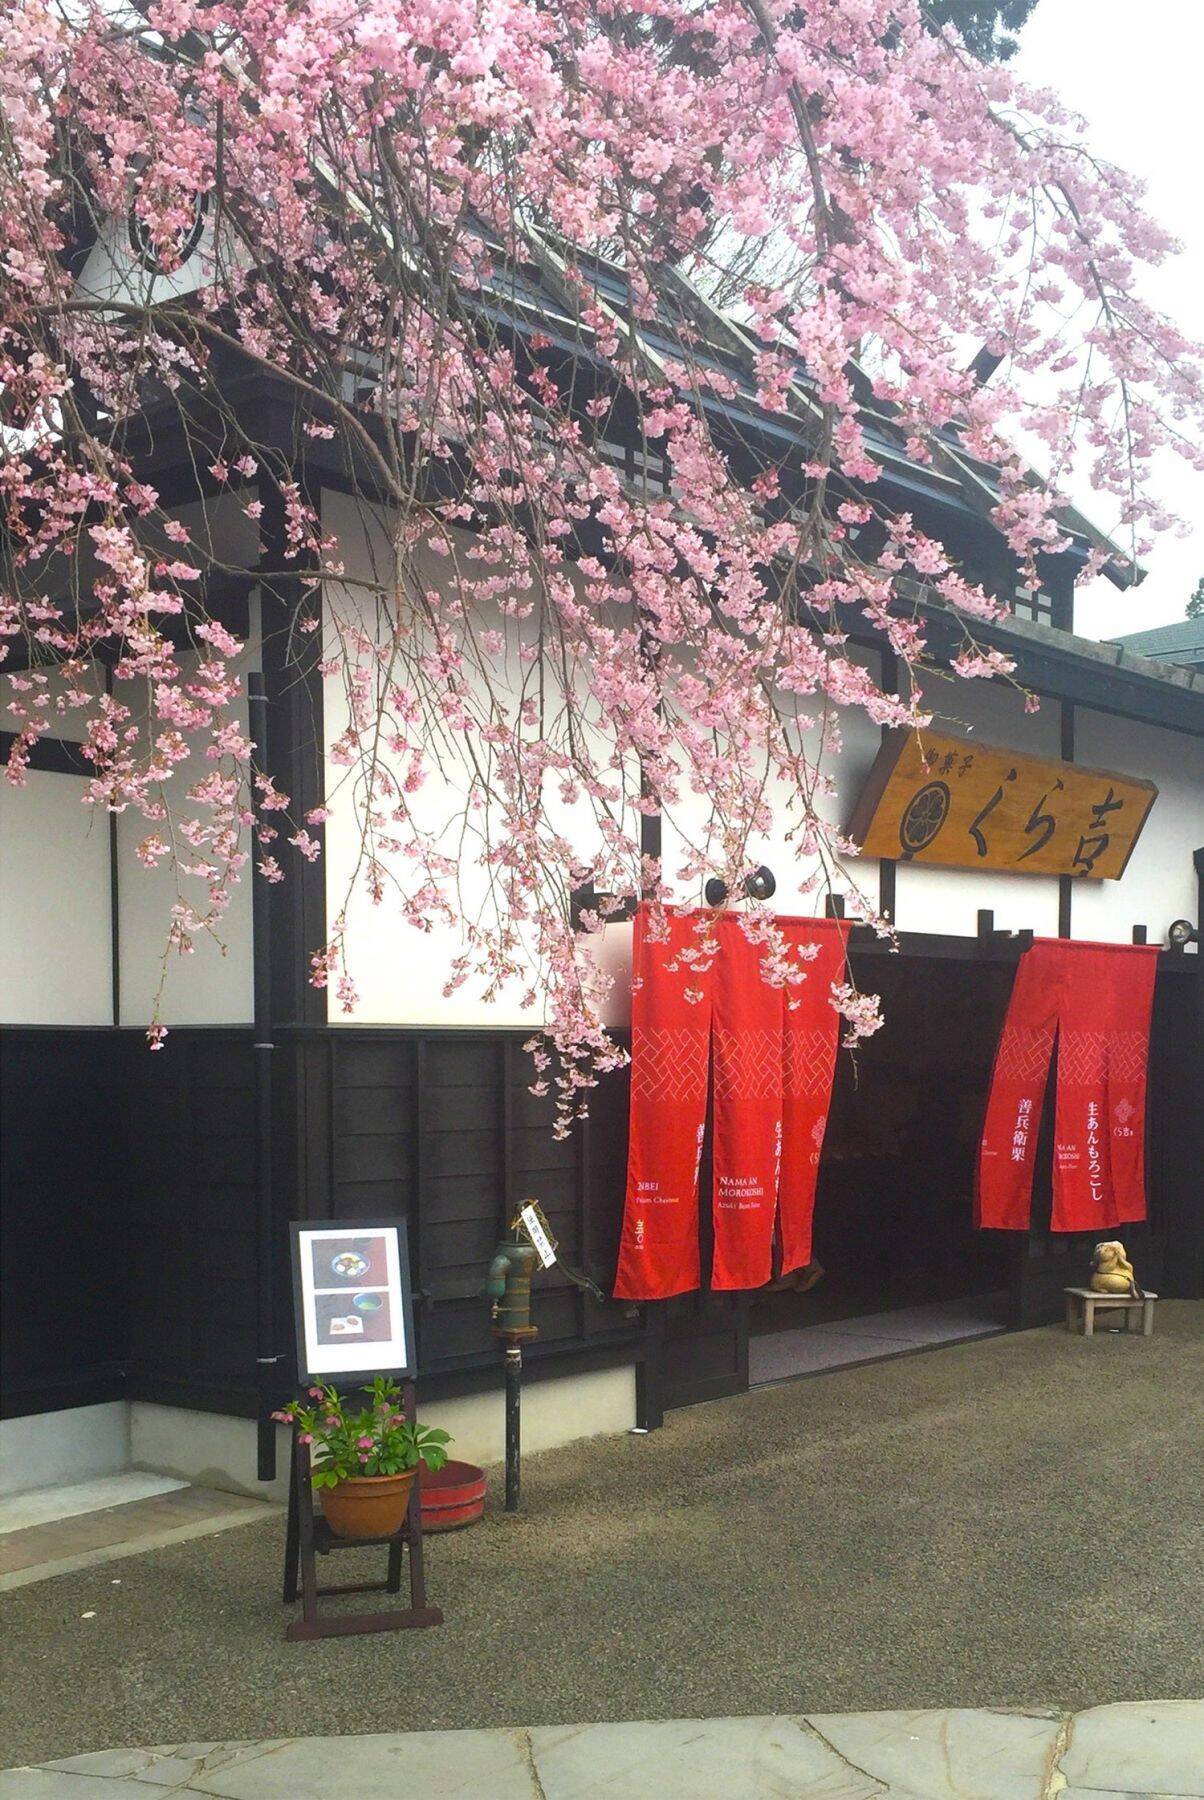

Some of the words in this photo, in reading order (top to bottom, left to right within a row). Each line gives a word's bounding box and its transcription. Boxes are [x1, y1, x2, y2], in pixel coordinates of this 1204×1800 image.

[968, 768, 1124, 871] くら吉
[1011, 1098, 1033, 1162] 善兵衛栗
[1086, 1101, 1103, 1202] 生あんもろこし
